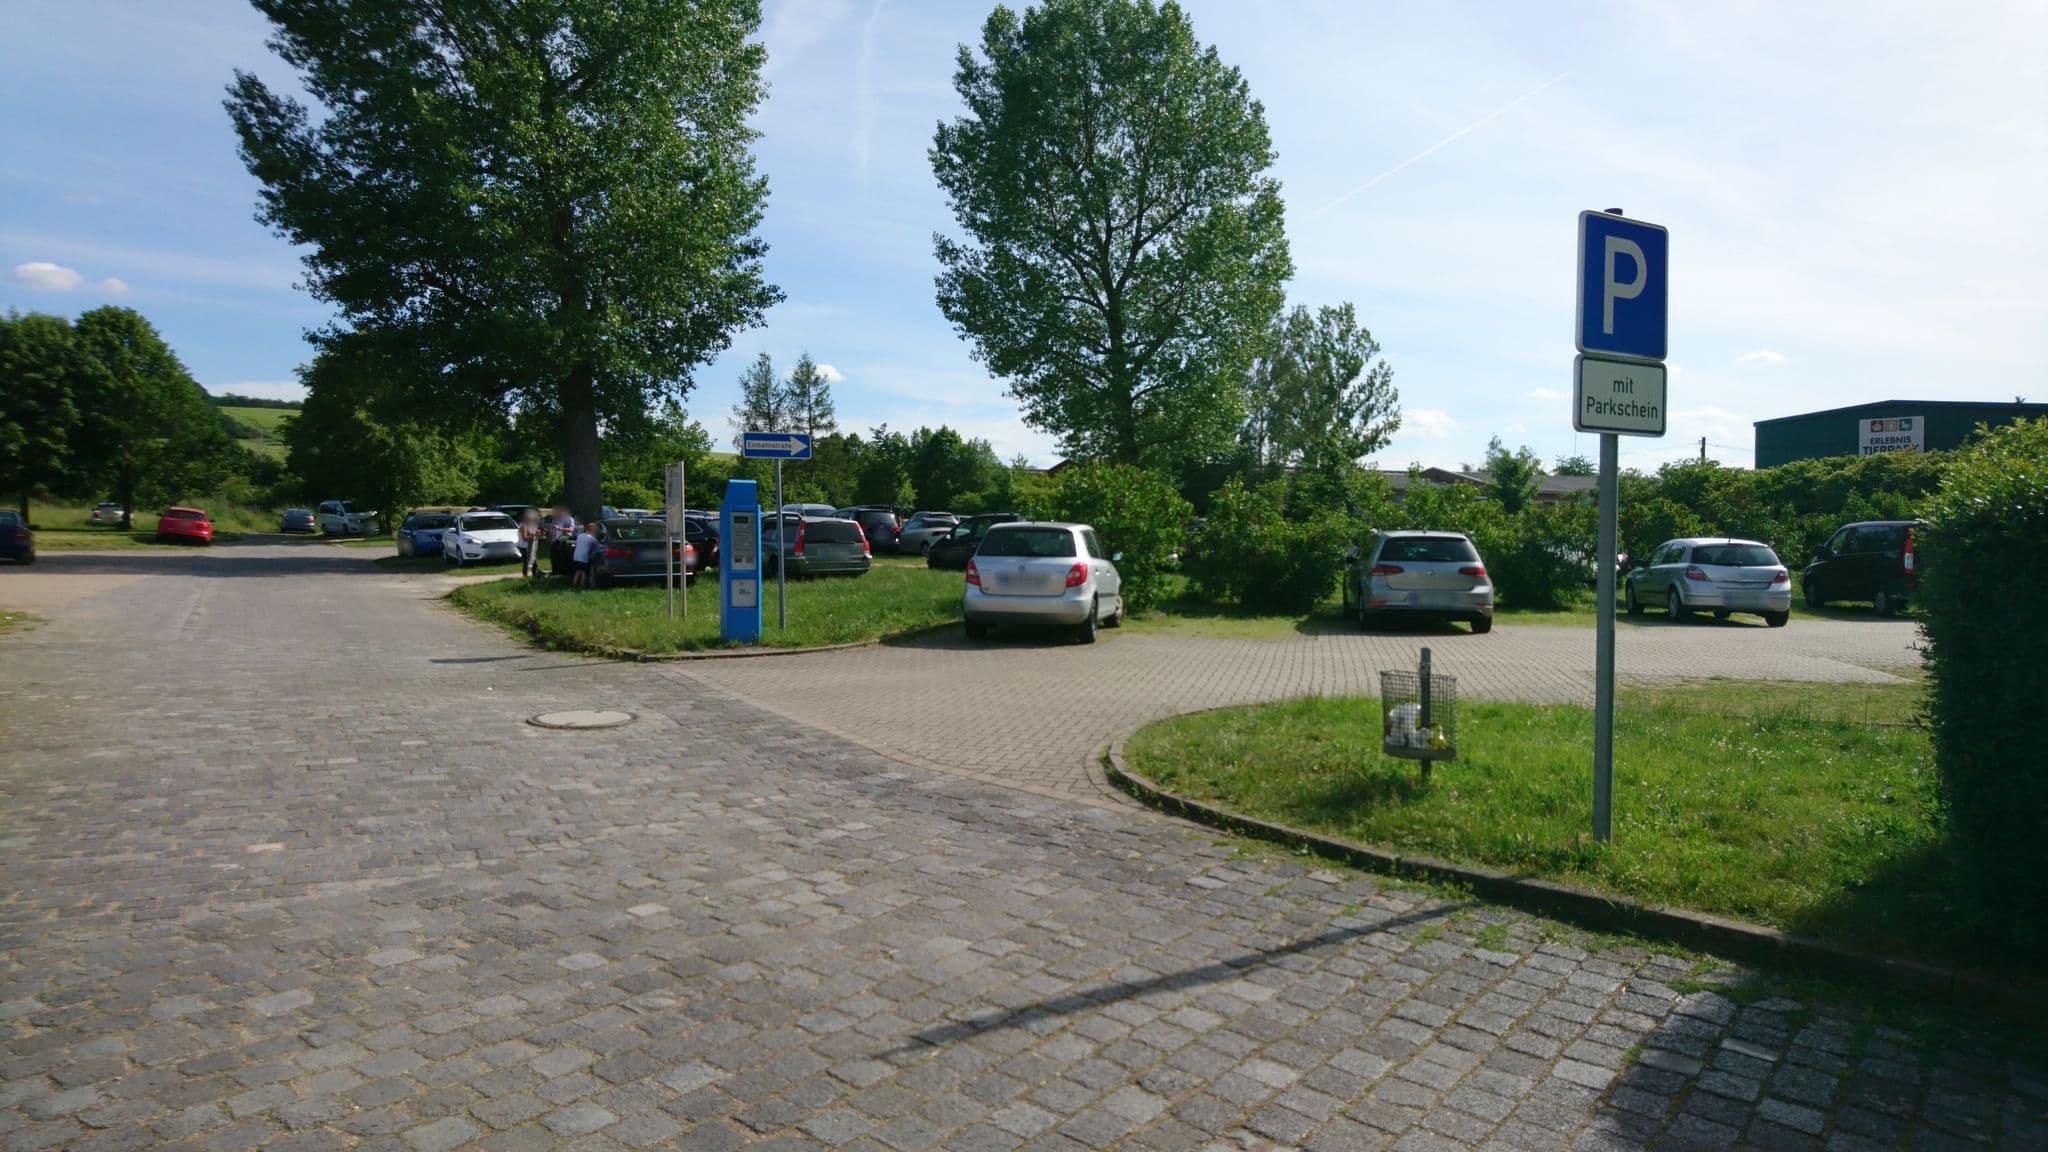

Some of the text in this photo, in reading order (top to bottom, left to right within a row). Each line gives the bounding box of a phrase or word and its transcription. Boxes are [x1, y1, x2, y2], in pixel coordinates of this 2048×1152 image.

[1603, 235, 1648, 335] P
[1613, 377, 1634, 394] mit
[1586, 396, 1659, 420] Parkschein
[1870, 436, 1912, 445] ERLEBNIS
